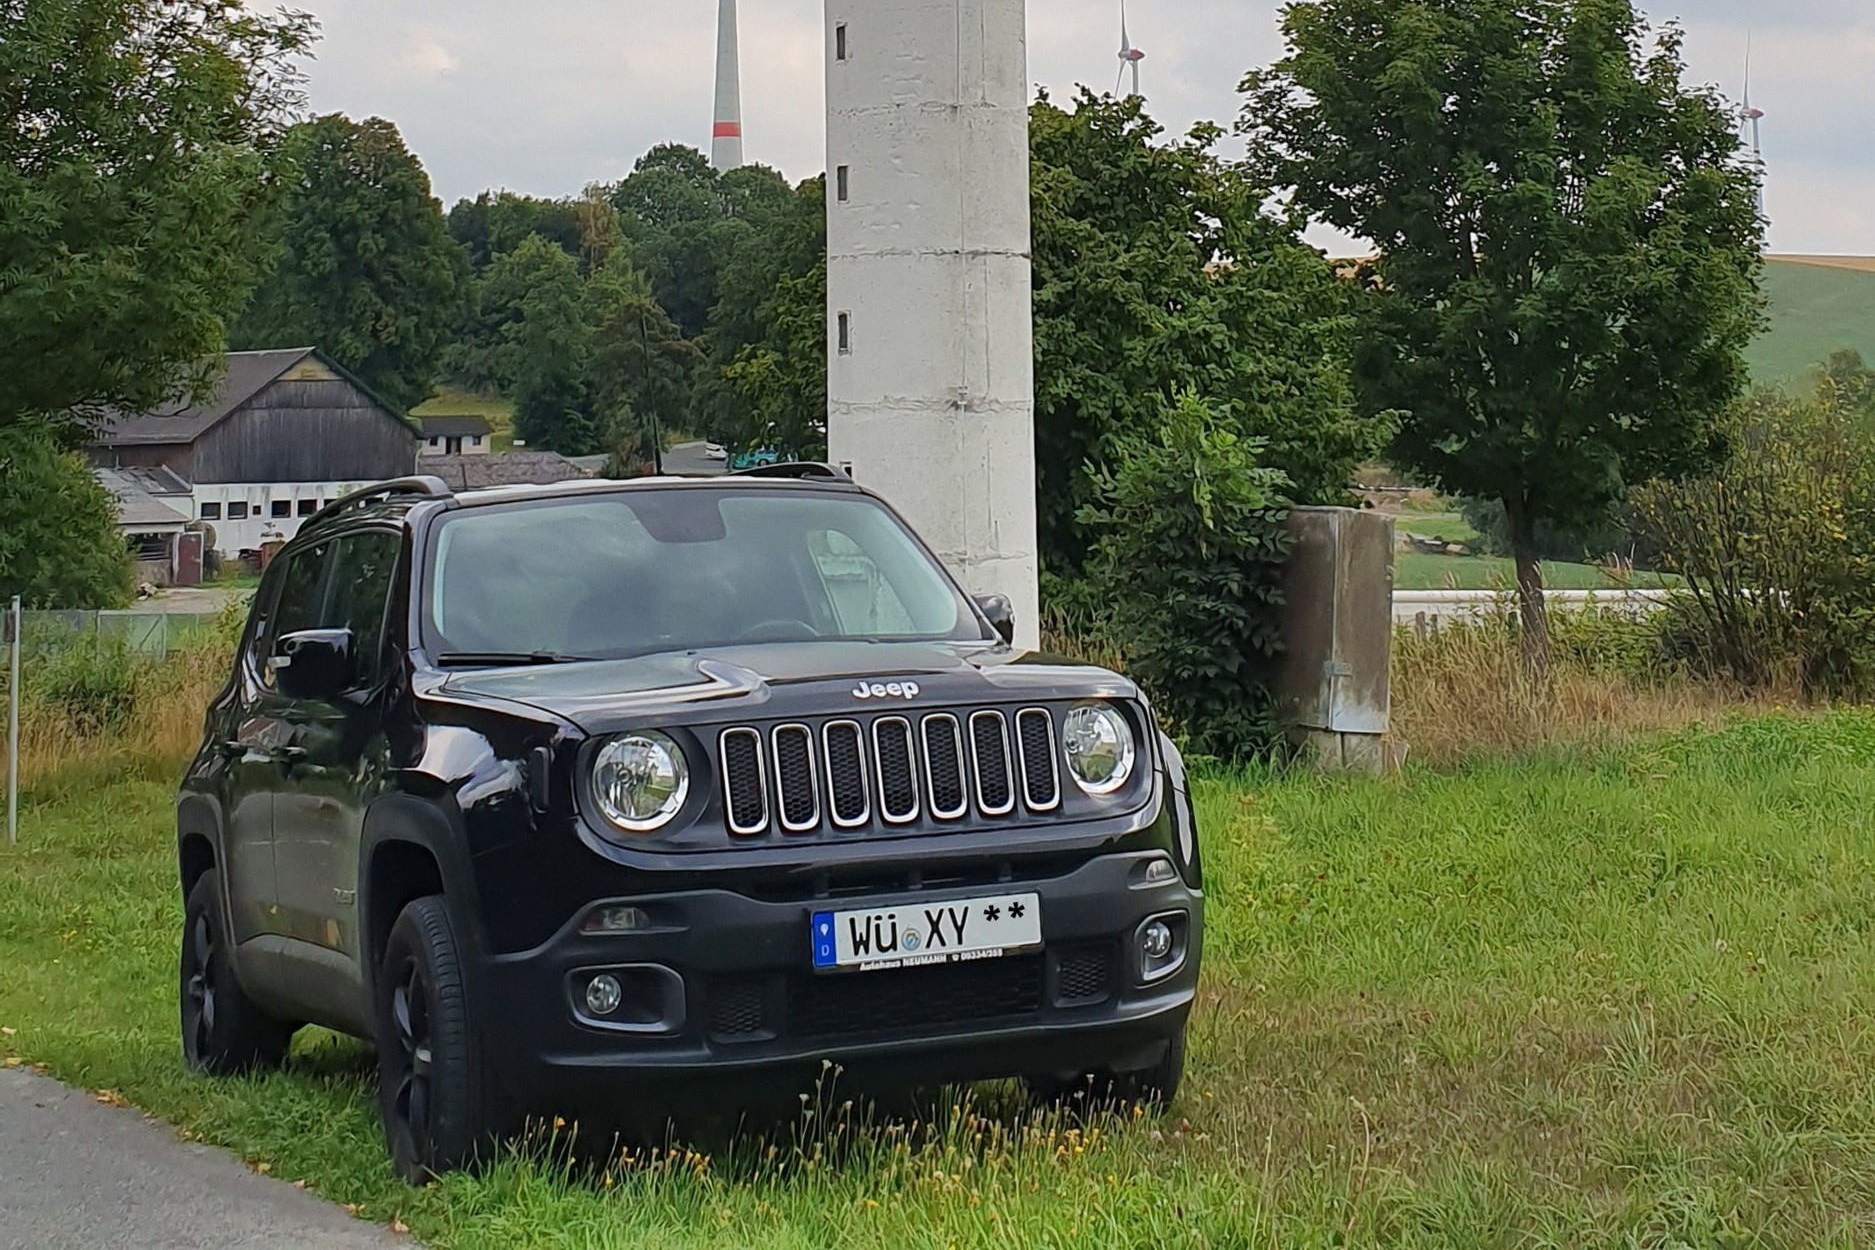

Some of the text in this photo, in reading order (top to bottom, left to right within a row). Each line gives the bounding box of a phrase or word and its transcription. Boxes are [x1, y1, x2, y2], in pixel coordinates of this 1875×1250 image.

[852, 681, 919, 699] Jeep
[924, 906, 969, 949] XY
[821, 944, 830, 957] D
